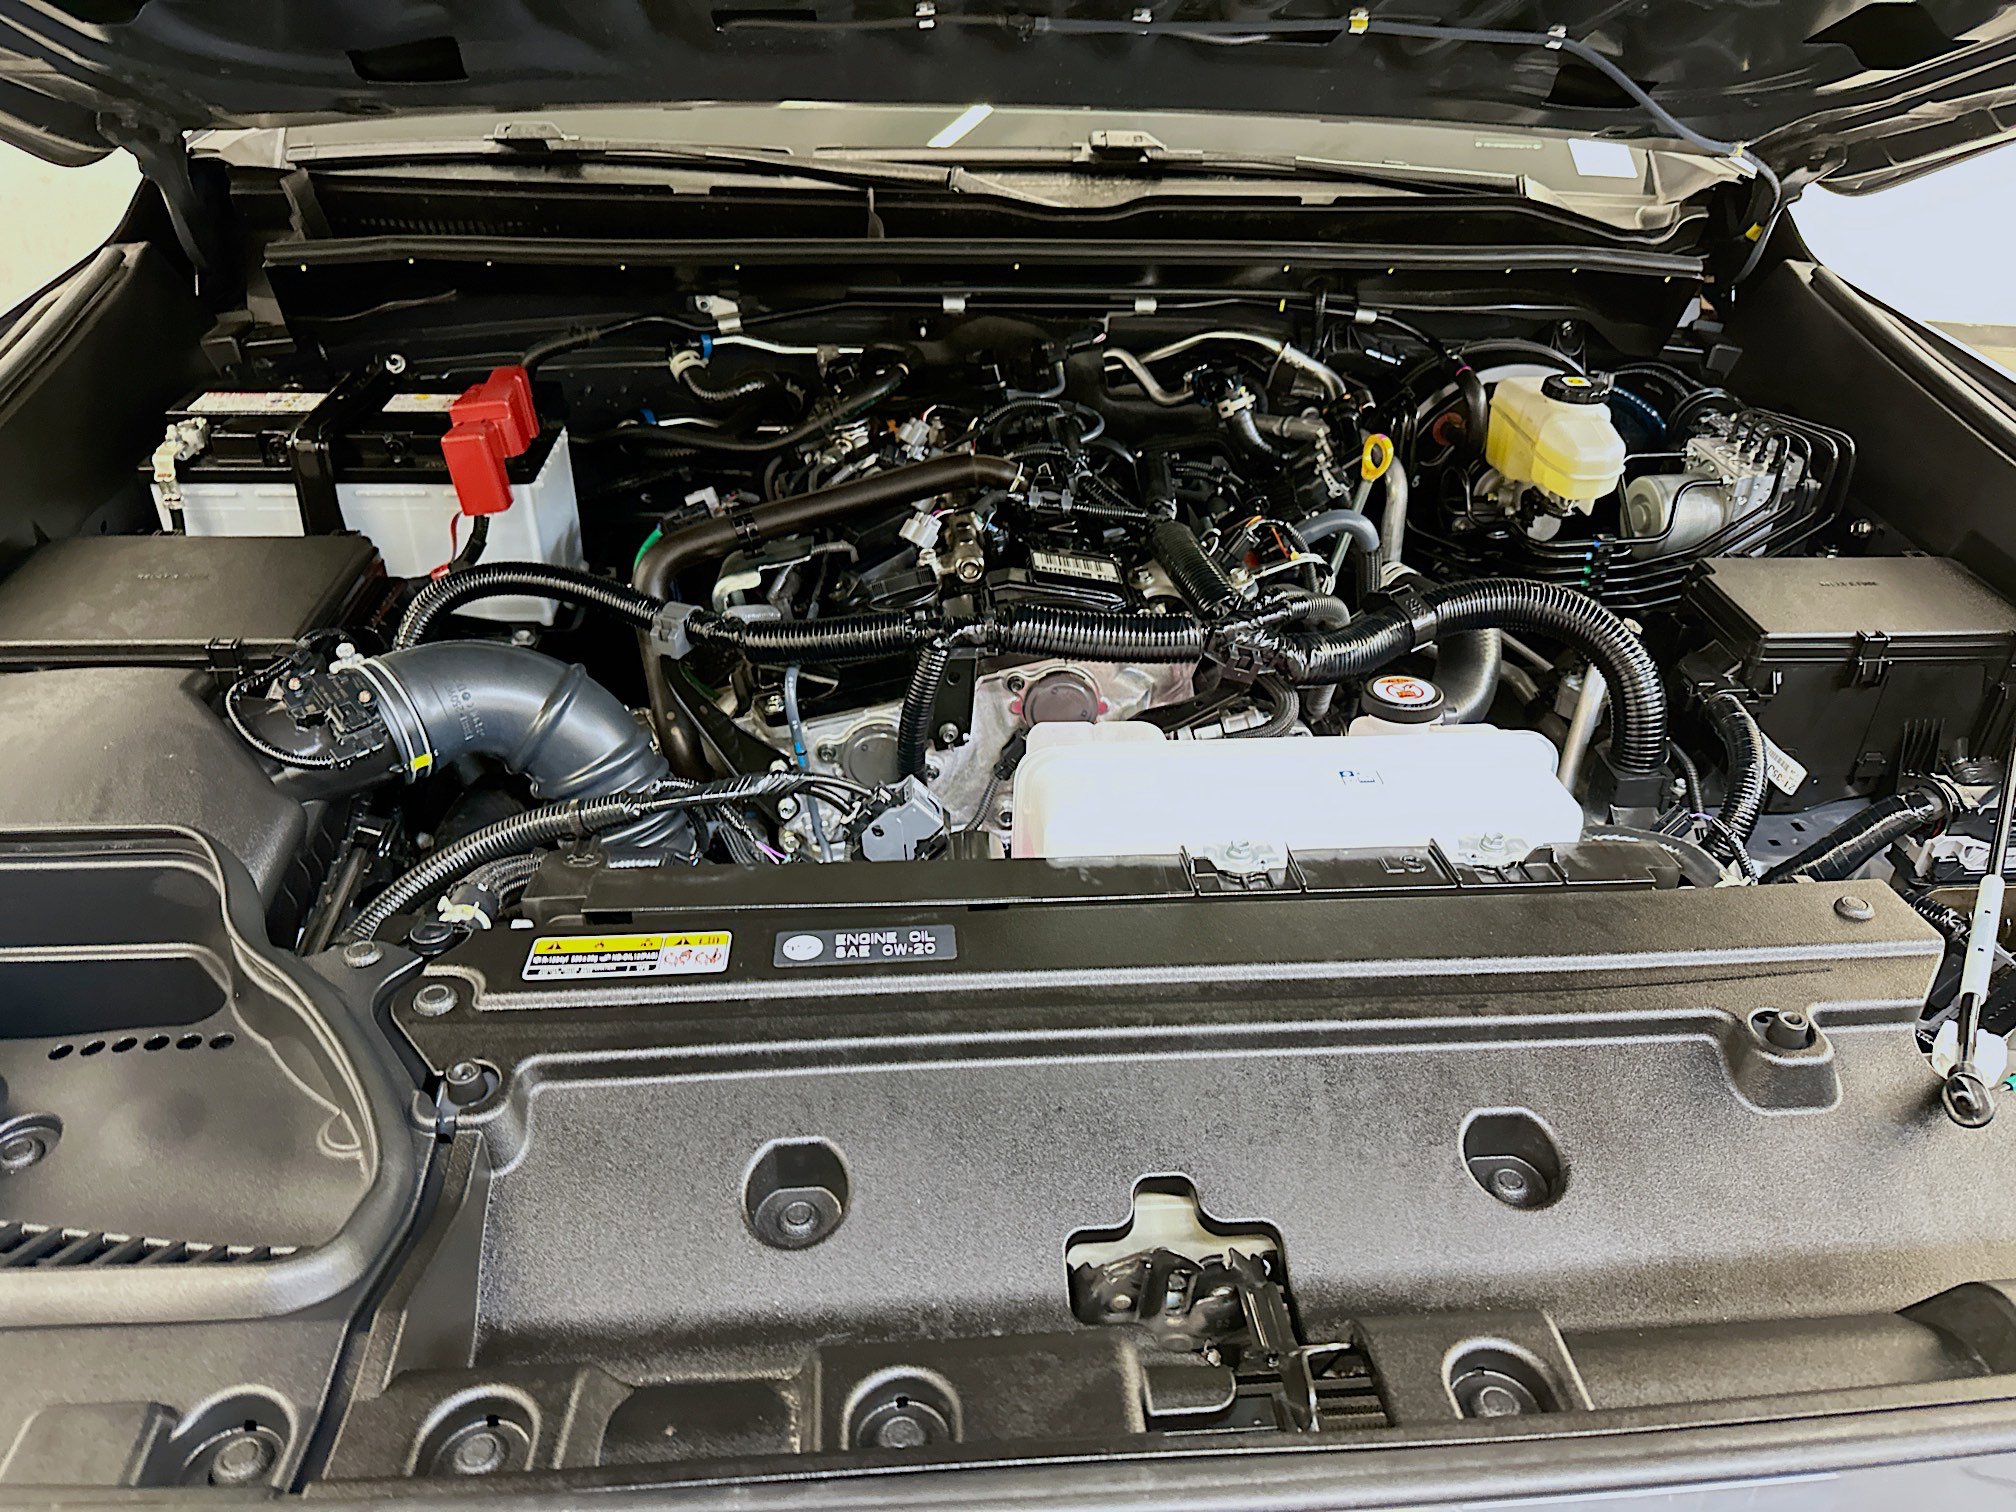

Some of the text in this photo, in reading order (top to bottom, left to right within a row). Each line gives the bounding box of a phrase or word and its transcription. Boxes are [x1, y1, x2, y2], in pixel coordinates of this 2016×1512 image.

[835, 930, 936, 946] ENGINE OIL
[835, 942, 936, 959] SAE 0W-20
